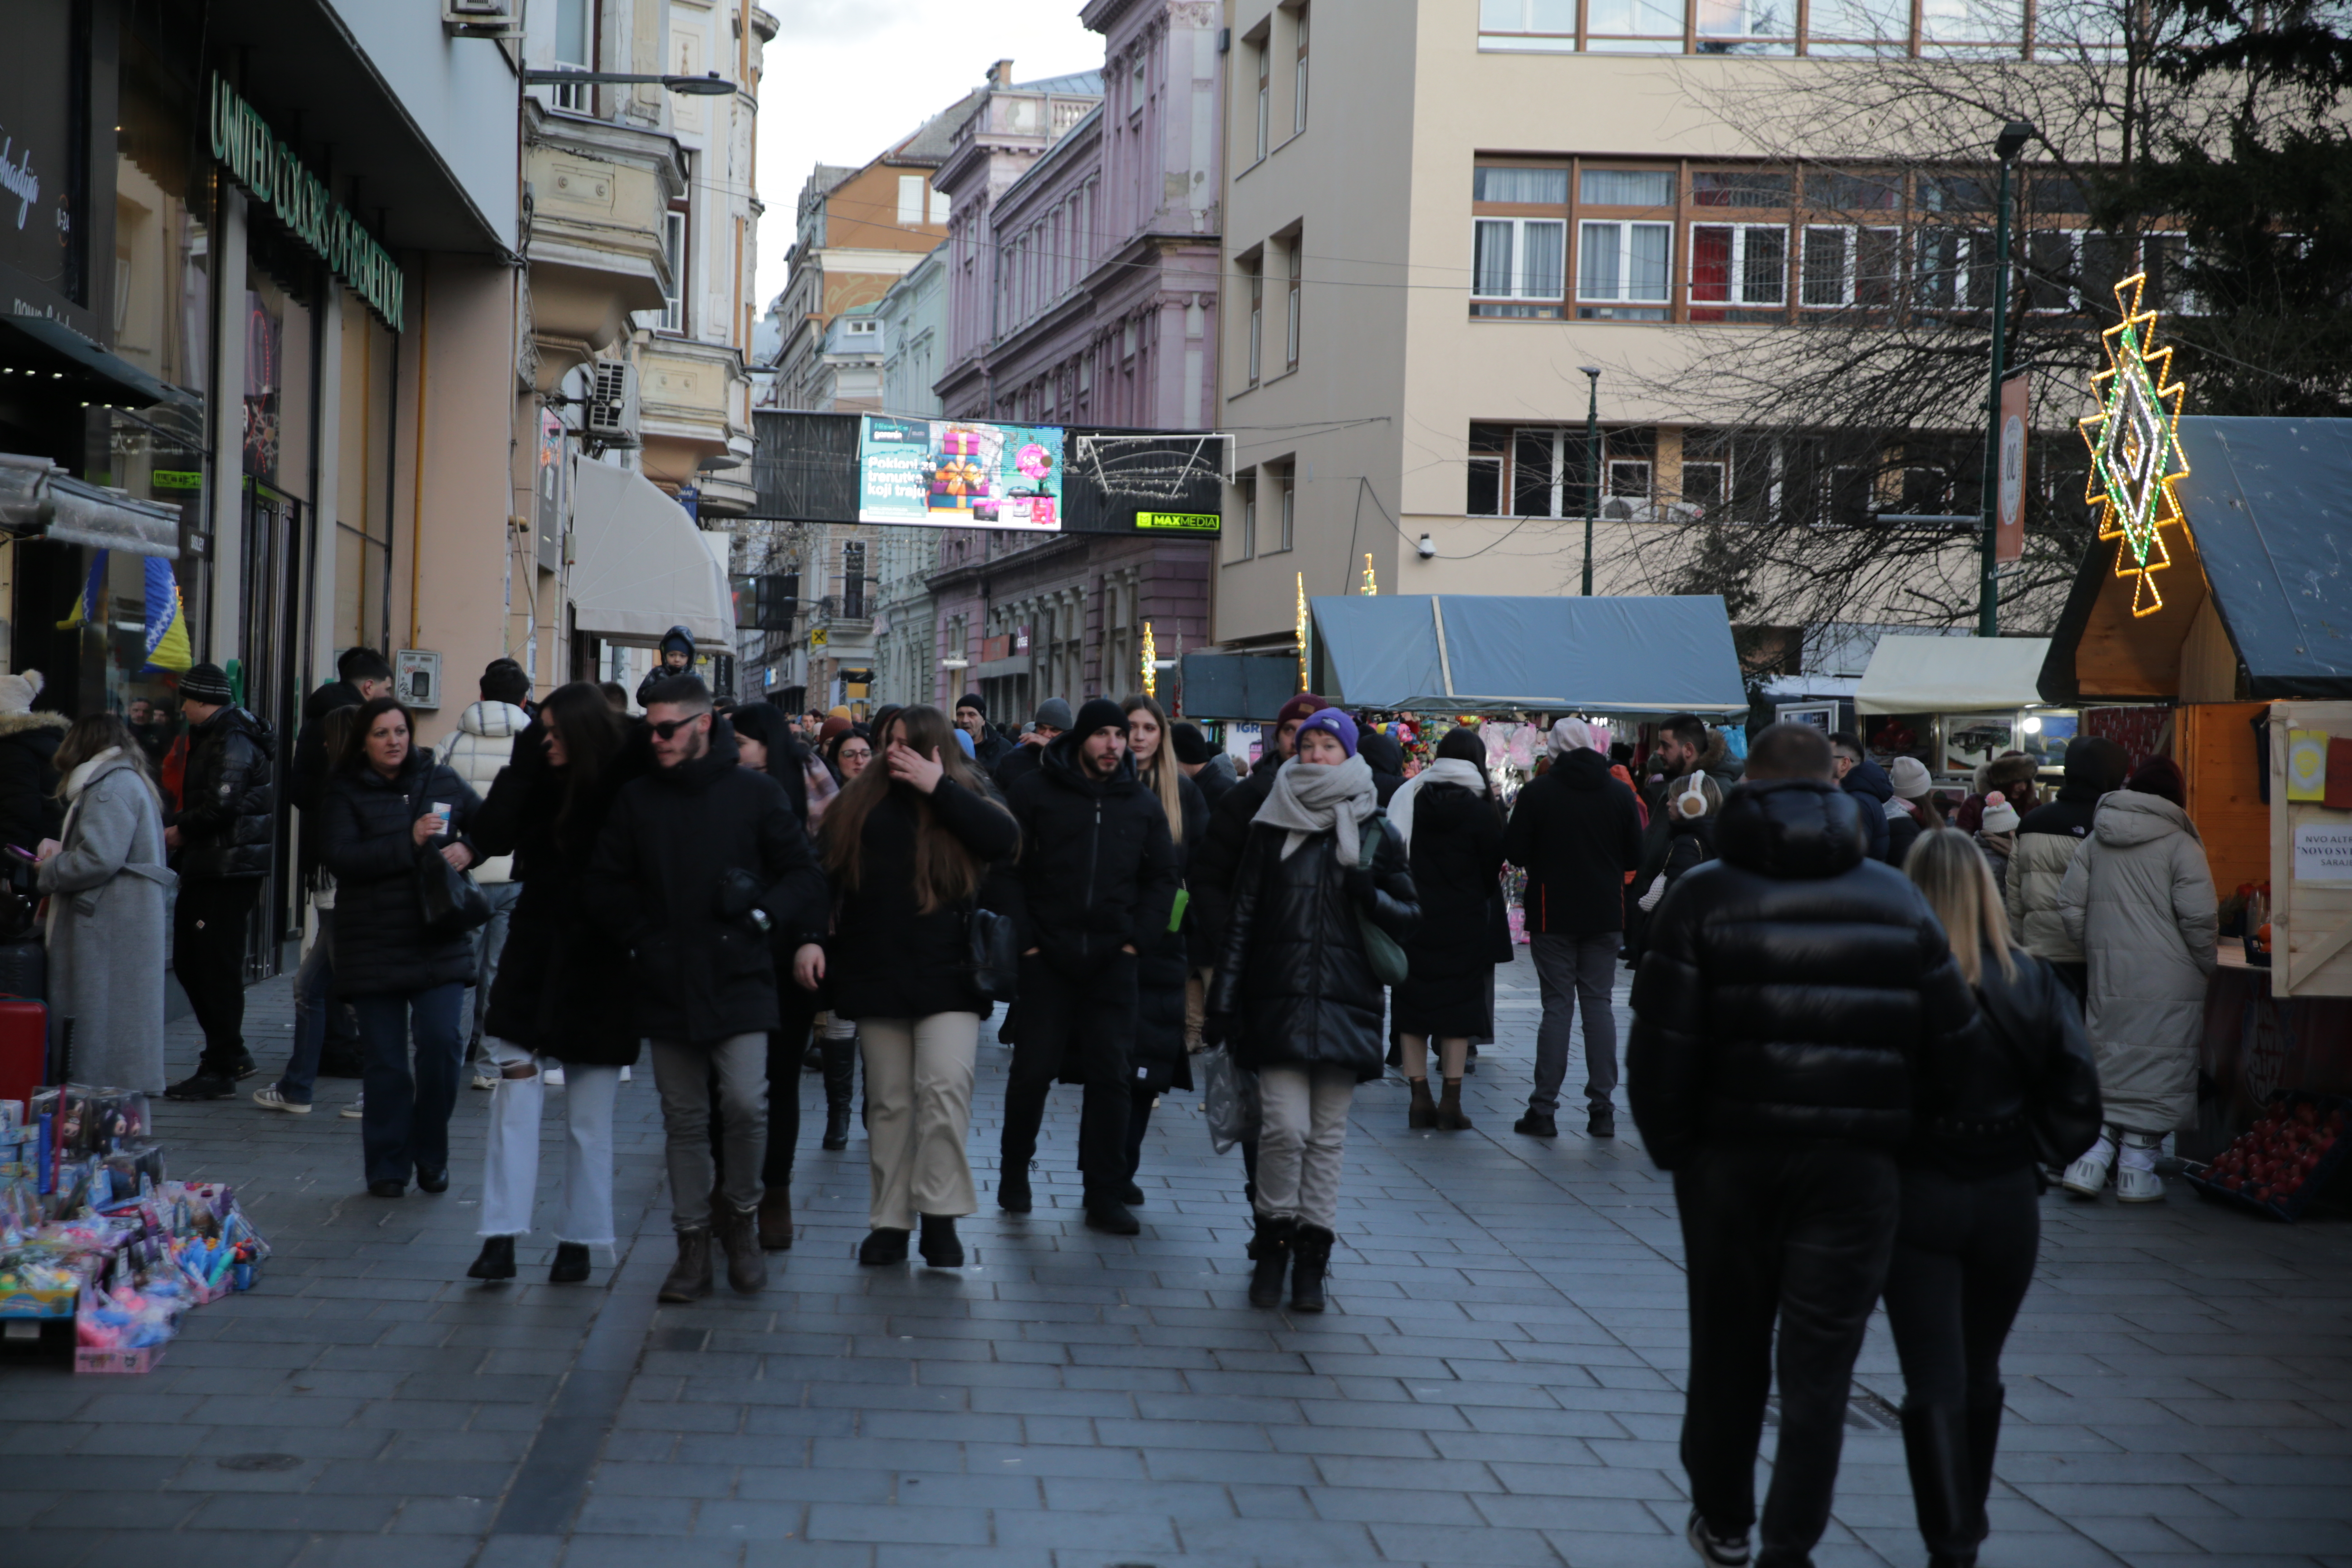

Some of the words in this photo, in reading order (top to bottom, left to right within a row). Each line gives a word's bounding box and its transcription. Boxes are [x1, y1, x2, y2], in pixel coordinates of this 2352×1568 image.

[211, 69, 273, 203] UNITED
[274, 141, 329, 260] COLORS
[330, 202, 352, 276] OF
[349, 219, 404, 334] BENETTON
[57, 207, 69, 233] 0-24
[868, 456, 918, 469] Pokloni
[921, 461, 937, 471] za
[867, 482, 892, 498] koji
[895, 484, 926, 500] traju
[1154, 515, 1216, 527] MAXMEDIA
[191, 534, 204, 552] SISLEY
[1236, 722, 1261, 733] IGR
[2297, 846, 2333, 855] "NOVO
